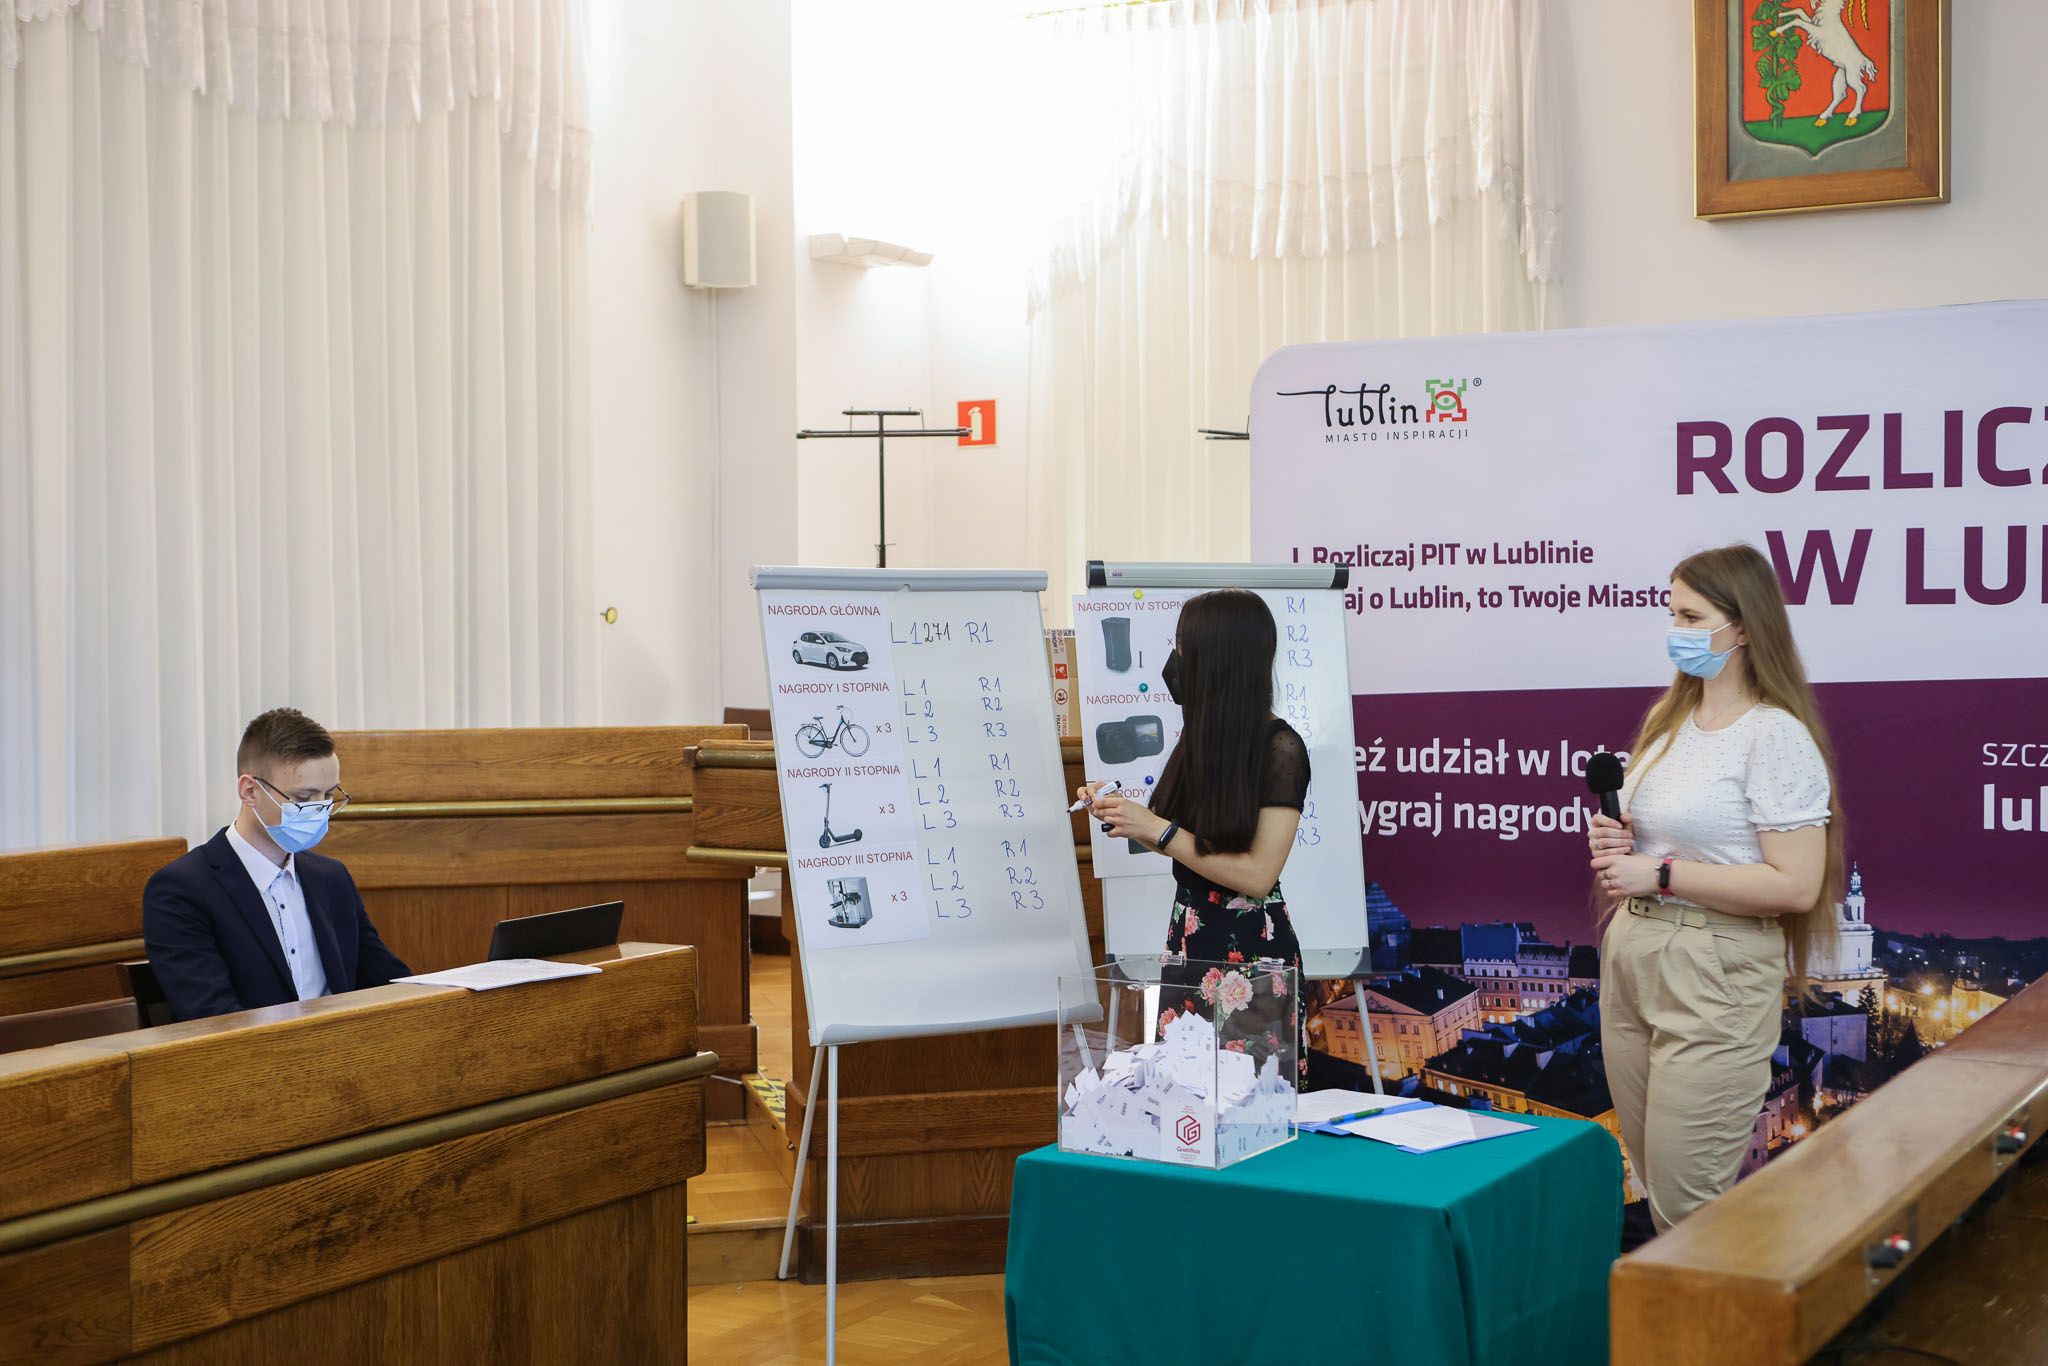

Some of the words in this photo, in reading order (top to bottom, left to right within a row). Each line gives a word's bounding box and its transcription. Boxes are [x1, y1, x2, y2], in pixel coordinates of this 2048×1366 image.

[1277, 383, 1418, 427] lublin
[1326, 433, 1377, 443] MIASTO
[1387, 429, 1467, 440] INSPIRACJI
[1676, 406, 2048, 496] ROZLIC
[1312, 543, 1416, 573] Rozliczaj
[1422, 543, 1460, 565] PIT
[1466, 549, 1486, 564] w
[1494, 540, 1593, 564] Lublinie
[1764, 527, 1874, 606] W
[1905, 524, 2048, 606] LU
[1079, 602, 1131, 611] NAGRODY
[1135, 602, 1144, 610] IV
[1147, 601, 1184, 611] STOPN
[1286, 597, 1305, 613] R1
[1344, 585, 1363, 615] aj
[1370, 593, 1383, 609] o
[1391, 585, 1471, 612] Lublin,
[1478, 588, 1502, 608] to
[1508, 584, 1580, 613] Twoje
[1590, 584, 1671, 608] Miasto
[768, 605, 827, 615] NAGRODA
[830, 604, 880, 615] GŁÓWNA
[1286, 624, 1308, 642] R2
[1288, 649, 1312, 667] R3
[779, 684, 833, 693] NAGRODY
[836, 683, 840, 693] I
[843, 682, 889, 692] STOPNIA
[978, 677, 1000, 692] R1
[981, 697, 1002, 711] R2
[1087, 695, 1140, 704] NAGRODY
[1143, 694, 1150, 702] V
[984, 723, 1007, 737] R3
[989, 753, 1010, 770] R1
[1354, 736, 1387, 772] eź
[1396, 737, 1510, 775] udział
[1517, 749, 1551, 777] w
[788, 767, 841, 778] NAGRODY
[845, 765, 852, 776] II
[854, 765, 900, 775] STOPNIA
[995, 779, 1019, 797] R2
[1118, 787, 1146, 799] RODY
[999, 804, 1024, 818] R3
[1358, 791, 1443, 838] ygraj
[1983, 783, 2048, 832] lu
[1295, 826, 1320, 846] R3
[1001, 839, 1026, 857] R1
[798, 856, 851, 868] NAGRODY
[854, 854, 864, 866] III
[867, 851, 913, 863] STOPNIA
[1006, 867, 1036, 885] R2
[1011, 890, 1044, 909] R3
